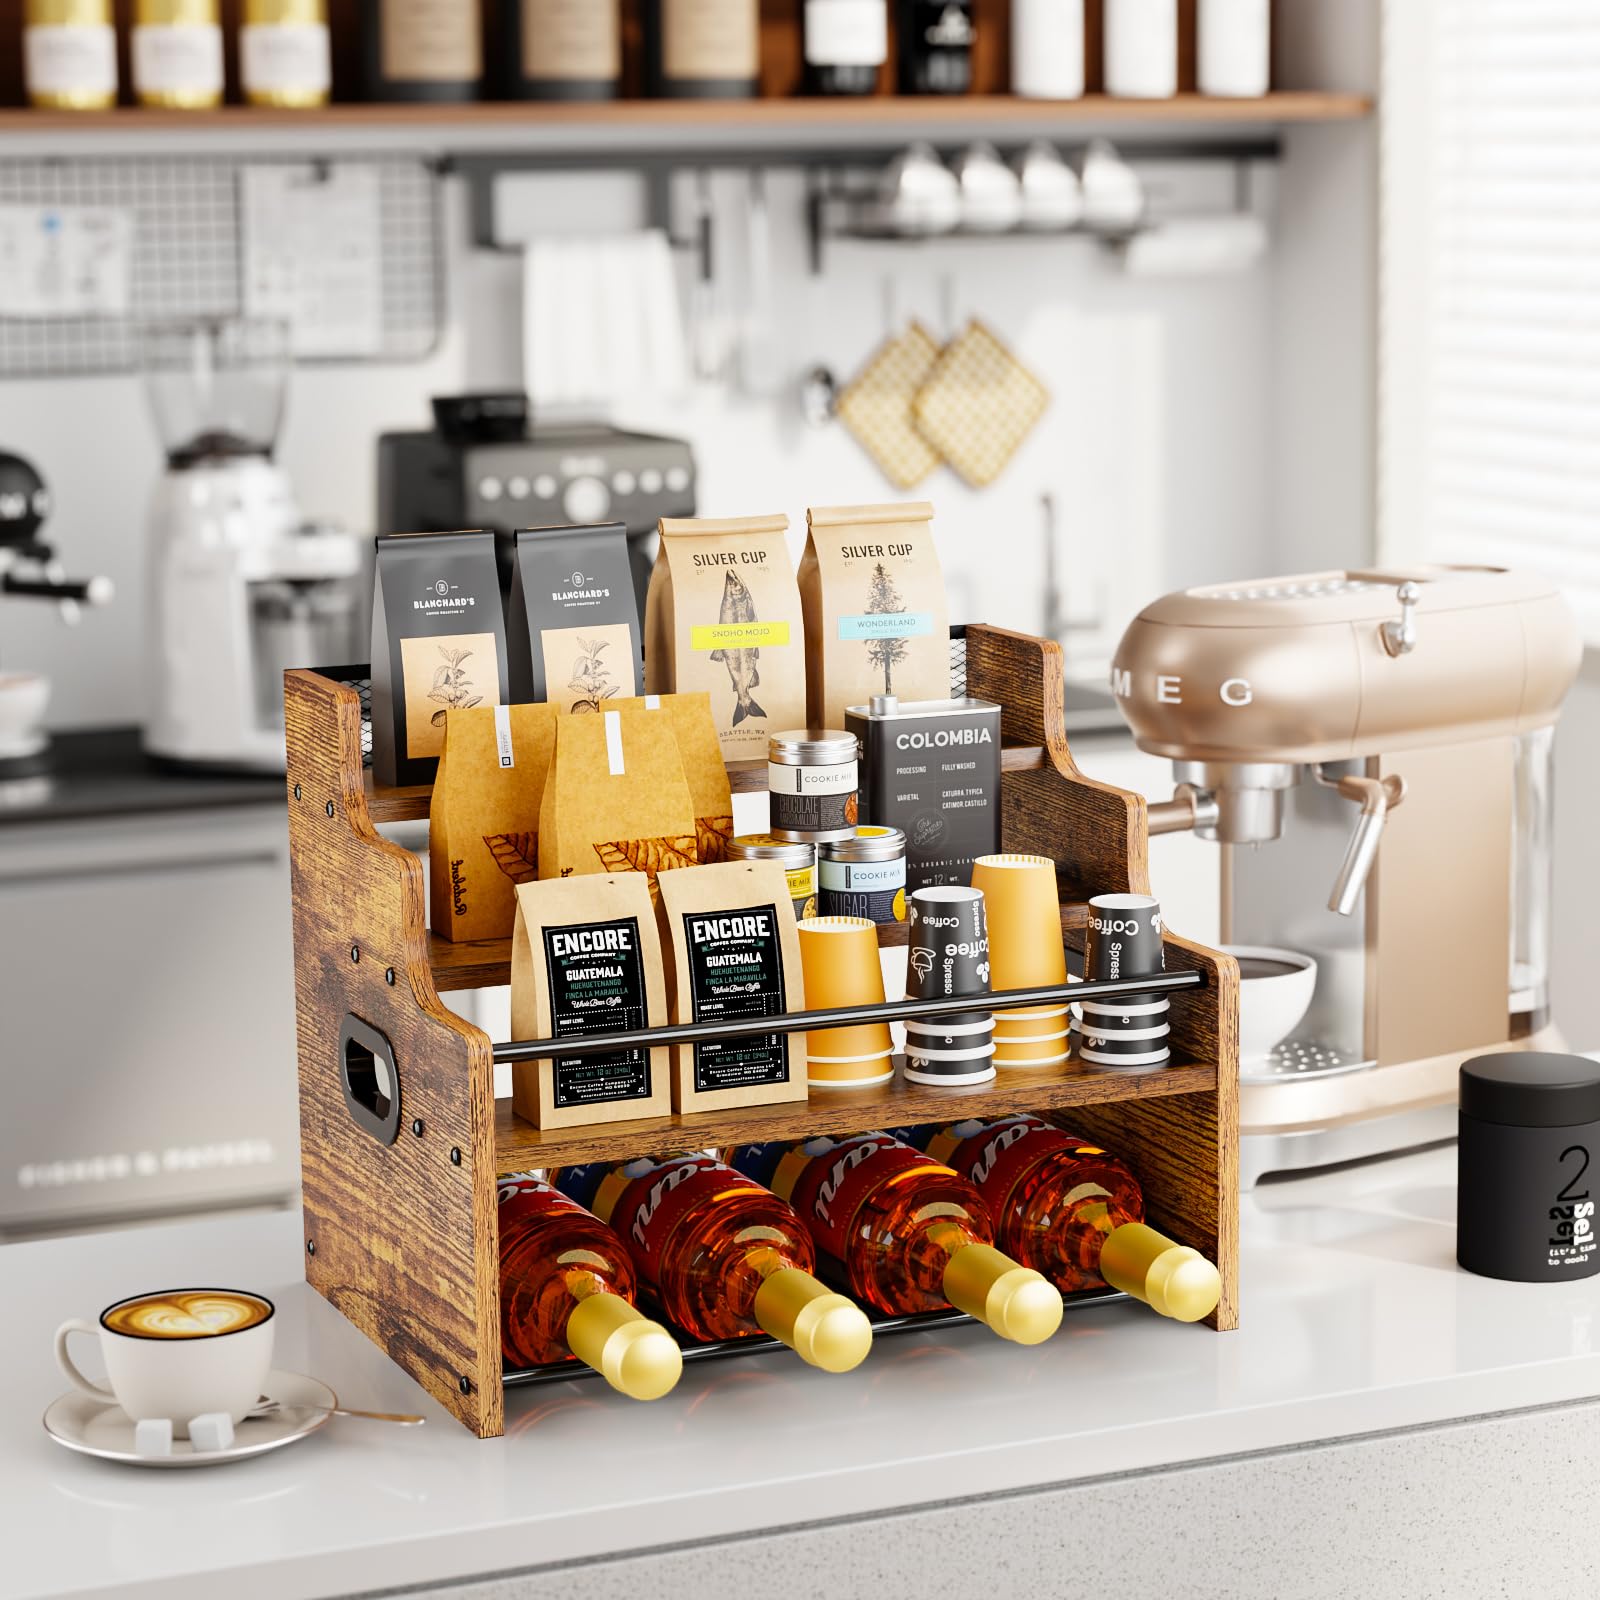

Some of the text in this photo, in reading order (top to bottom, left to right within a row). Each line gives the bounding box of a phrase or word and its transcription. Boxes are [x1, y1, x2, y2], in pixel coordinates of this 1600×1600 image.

[841, 543, 913, 559] SILVER CUP
[692, 551, 767, 567] SILVER CUP
[552, 588, 610, 601] BLANCHARD'S
[413, 597, 475, 609] BLANCHARD'S
[857, 618, 916, 628] WONDERLAND
[712, 628, 770, 638] SNOHO MOJO
[896, 727, 992, 750] COLOMBIA
[896, 765, 927, 775] PROCESSING
[941, 761, 976, 772] FULLY WASHED
[804, 774, 839, 783] COOKIE
[896, 793, 920, 802] VARIETAL
[965, 787, 983, 796] TYPICA
[780, 796, 819, 814] CHOCOLATE
[965, 798, 988, 808] CASTILLO
[853, 871, 888, 880] COOKIE
[799, 878, 811, 887] MIX
[829, 893, 868, 919] SUGAR
[922, 916, 960, 928] Coffee
[972, 900, 981, 937] Spresso
[692, 915, 771, 943] ENCORE
[1088, 916, 1139, 936] Coffee
[552, 928, 632, 957] ENCORE
[706, 951, 763, 968] GUATEMALA
[1109, 942, 1122, 980] Spress
[565, 965, 624, 982] GUATEMALA
[710, 964, 760, 976] HUEHUETENANGO
[942, 957, 954, 995] Spresso
[570, 978, 622, 990] HUEHUETENANGO
[705, 972, 767, 986] FINCA LA MARAVILLA
[565, 986, 629, 1000] FINCA LA MARAVILLA
[1556, 1145, 1591, 1202] 2
[1573, 1201, 1595, 1246] Sel
[1580, 1243, 1597, 1253] time
[1547, 1258, 1560, 1266] to
